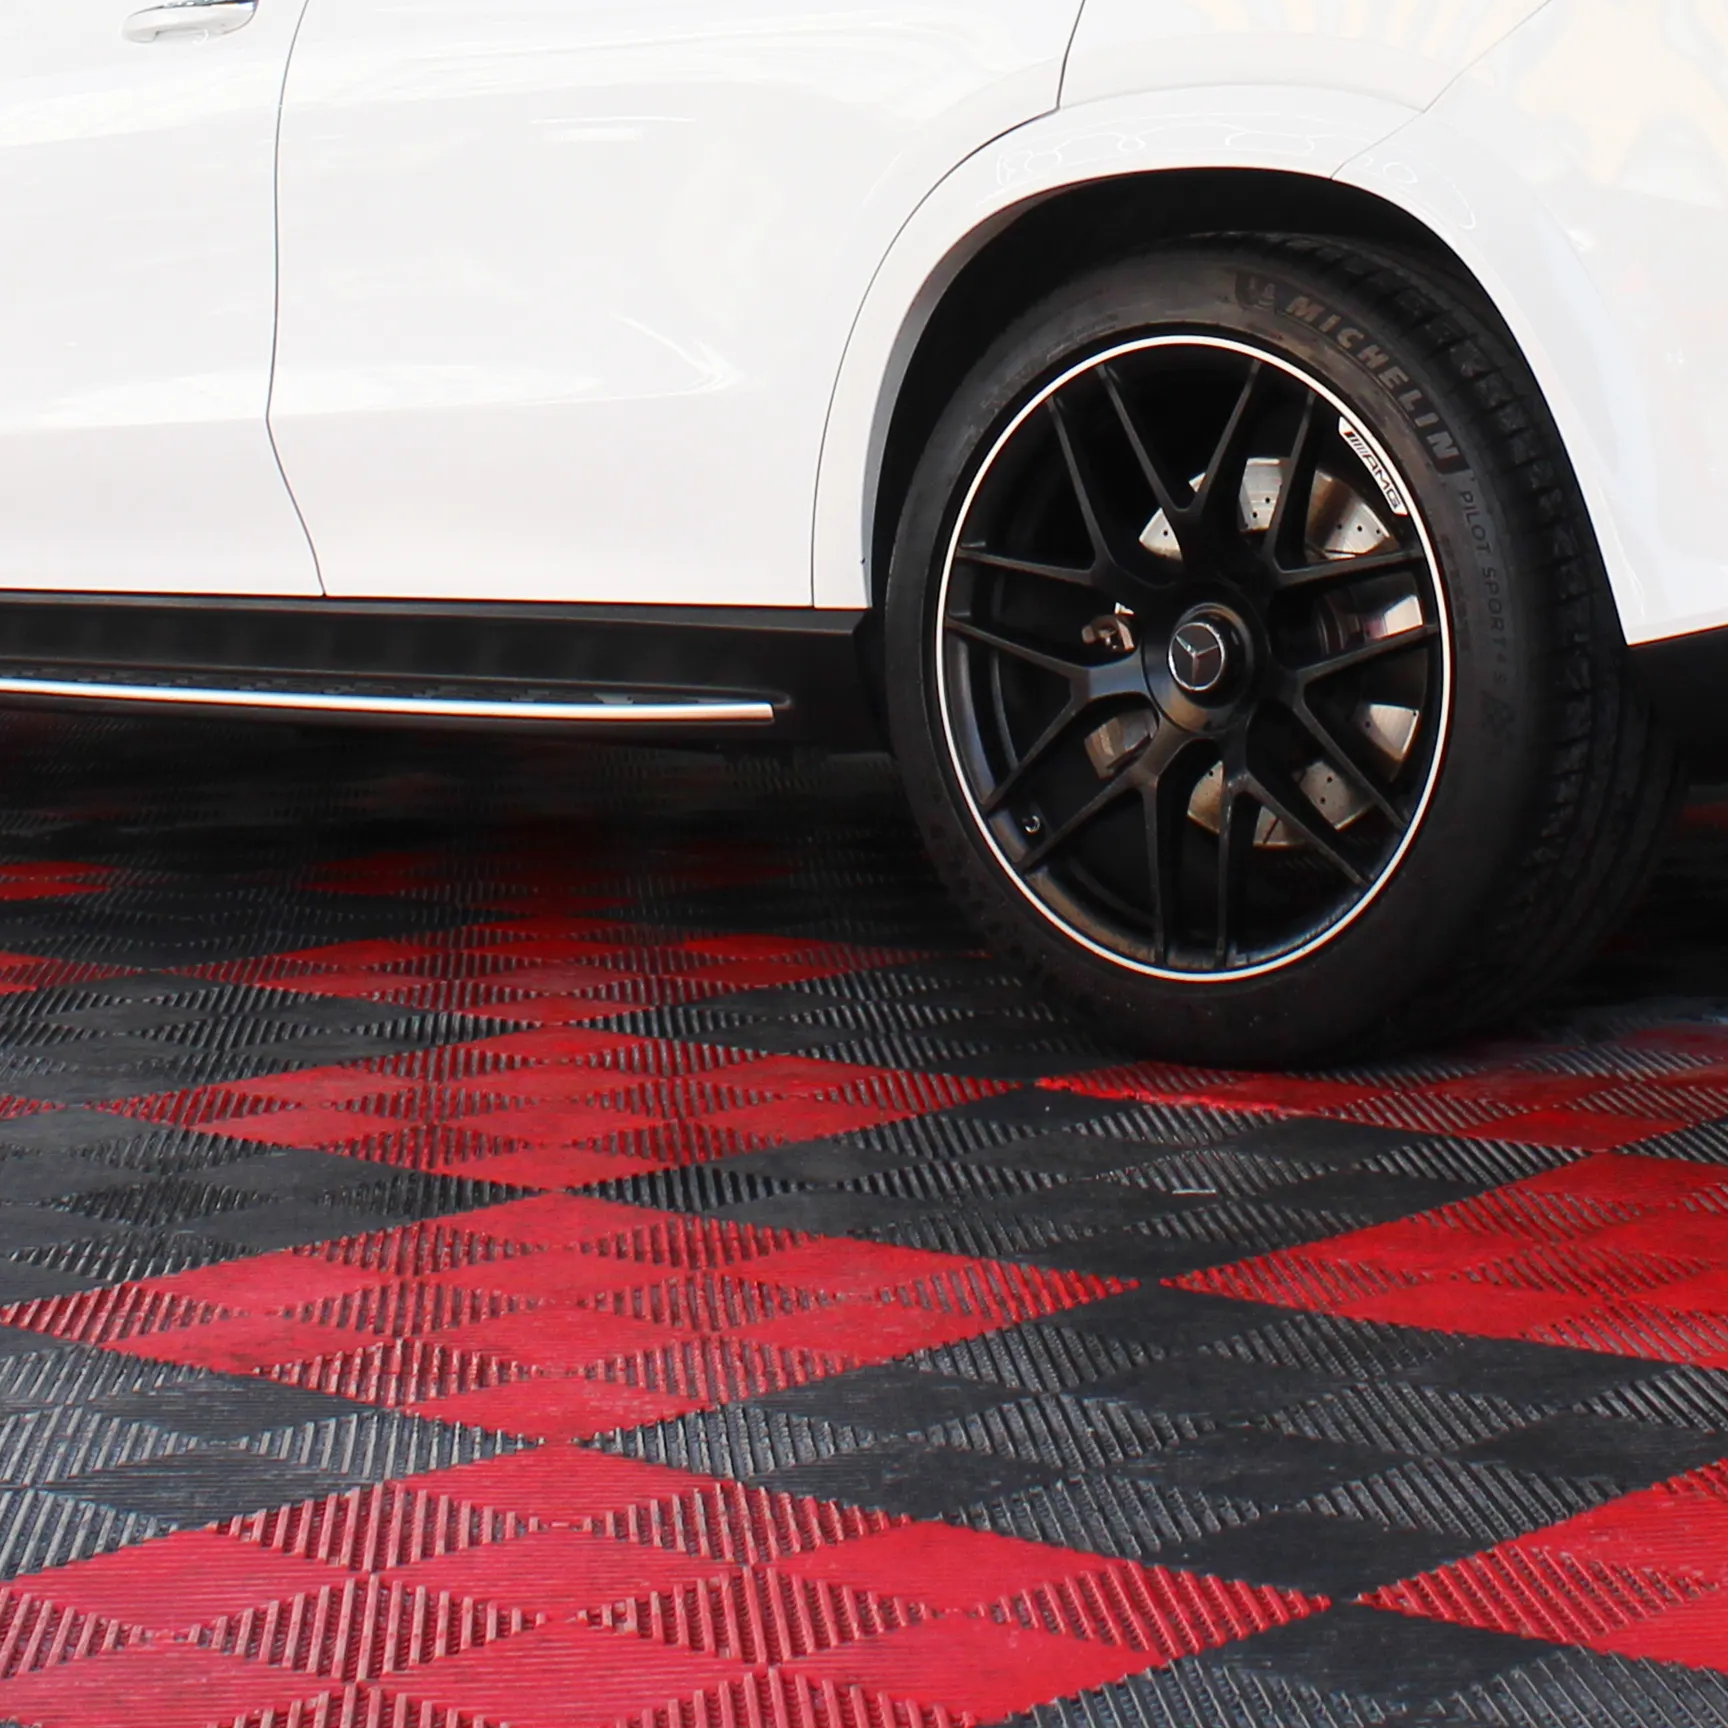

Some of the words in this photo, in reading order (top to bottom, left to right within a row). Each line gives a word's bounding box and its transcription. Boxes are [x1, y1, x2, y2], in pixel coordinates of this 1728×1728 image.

[1284, 292, 1462, 460] MICHELIN
[1460, 490, 1492, 554] PILOT
[1482, 567, 1507, 648] SPORT
